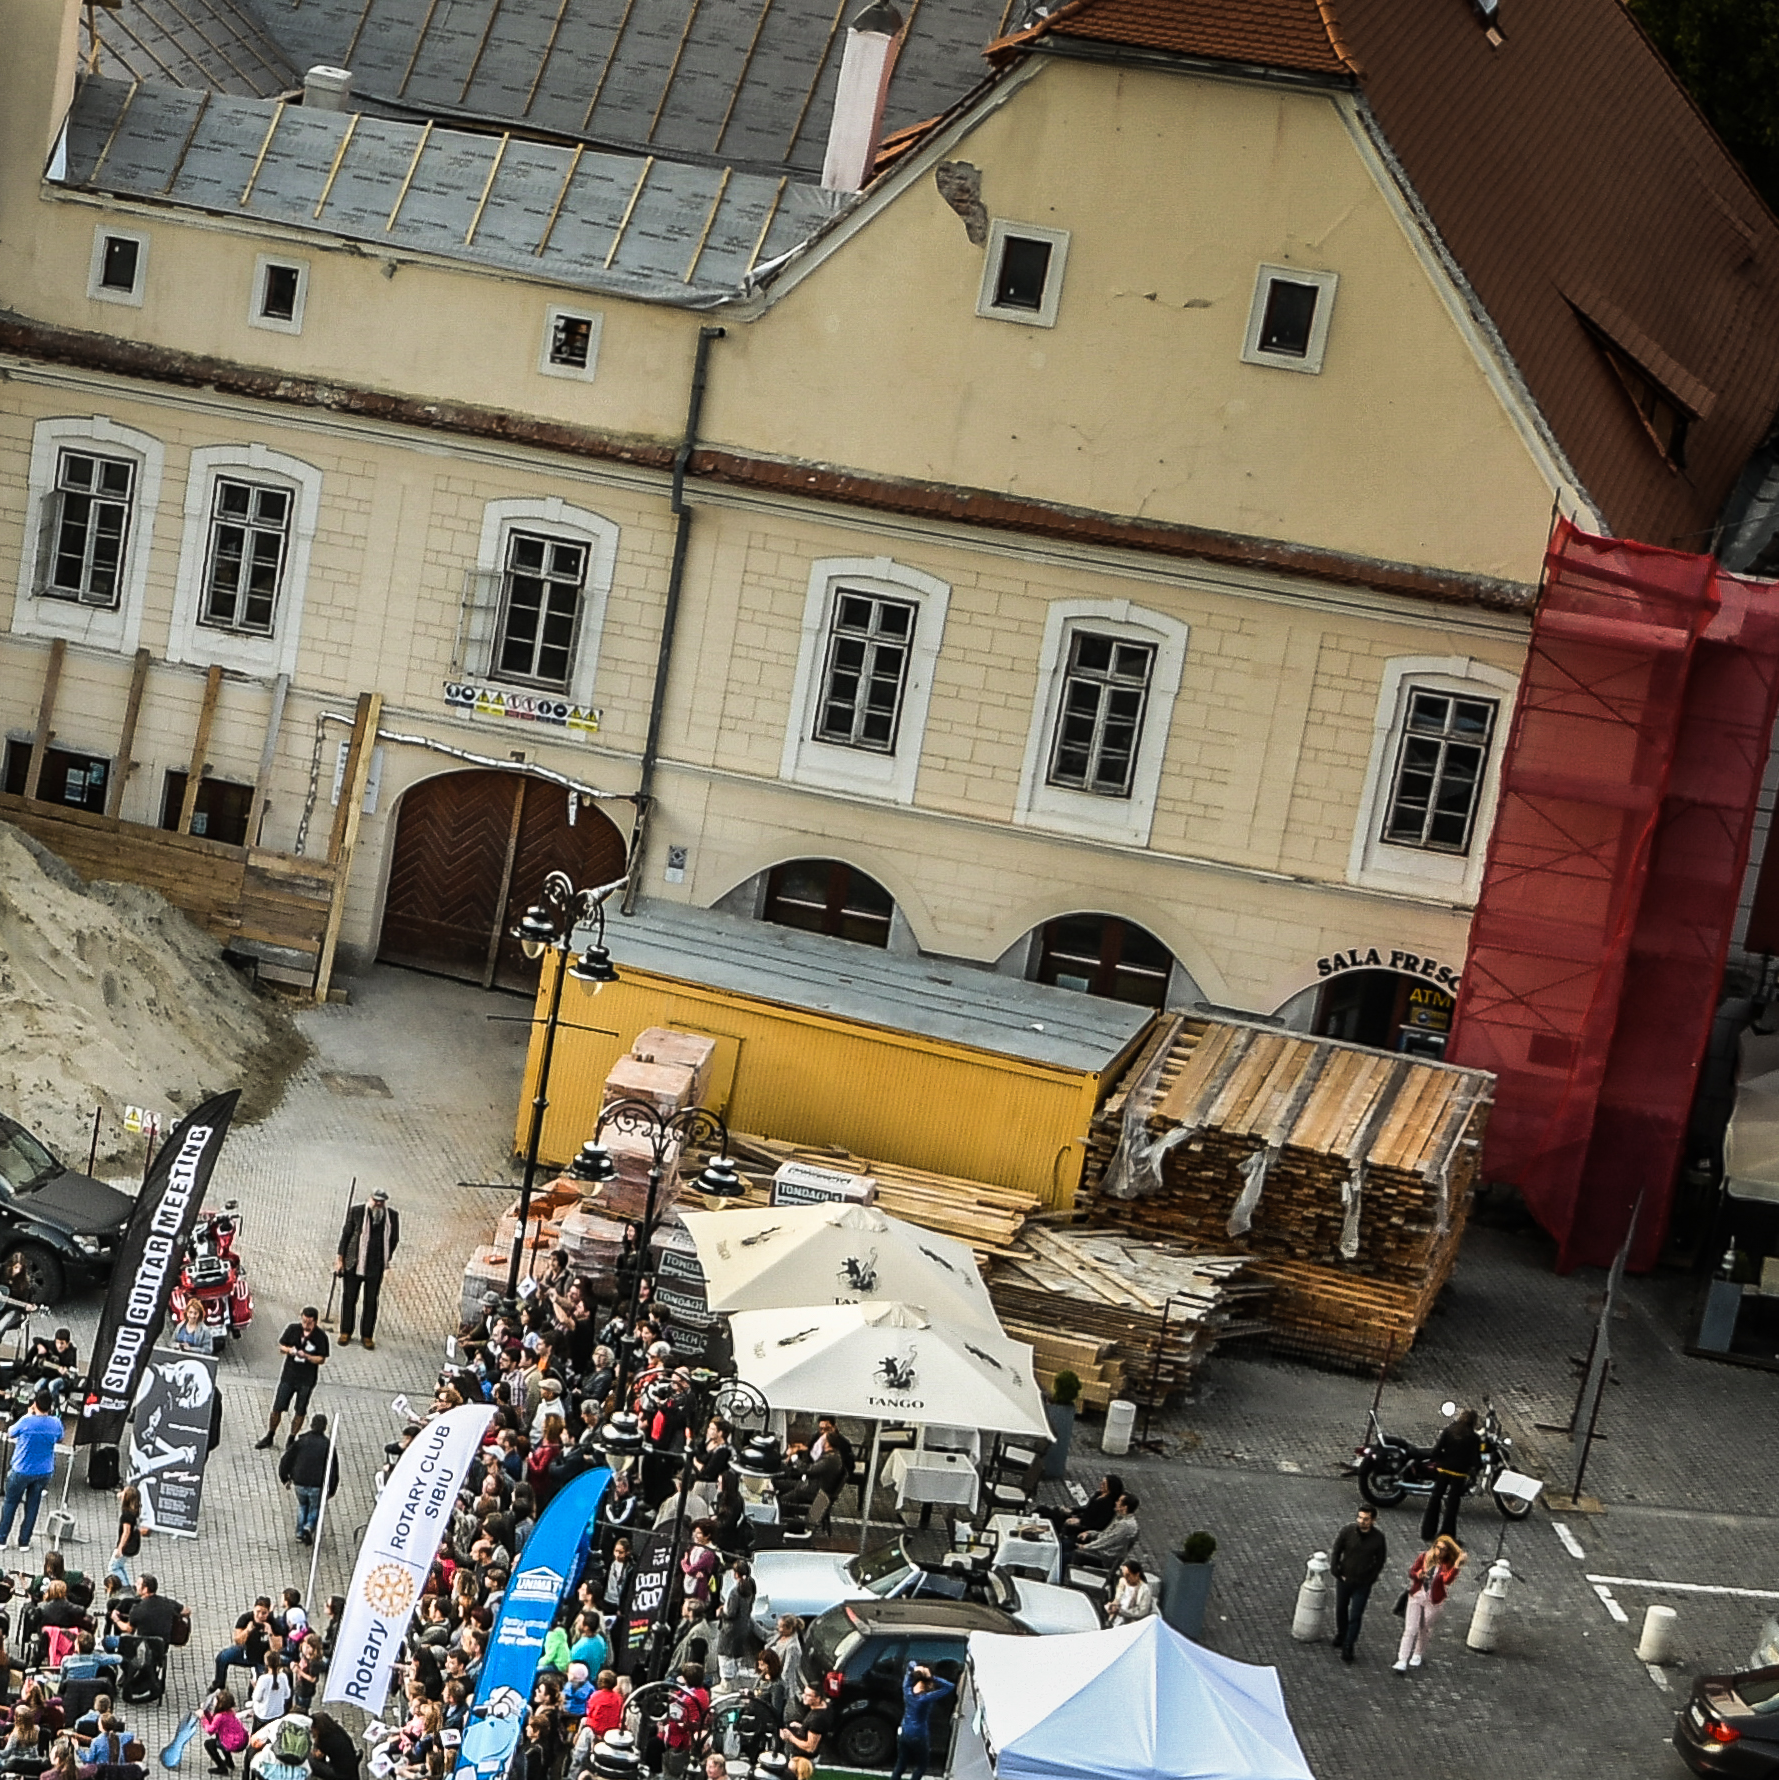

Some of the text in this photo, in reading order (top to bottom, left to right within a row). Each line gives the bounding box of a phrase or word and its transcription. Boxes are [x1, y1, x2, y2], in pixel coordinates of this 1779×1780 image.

[1316, 948, 1382, 977] SALA
[1410, 988, 1451, 1008] ATM
[105, 1328, 143, 1390] SIBIU
[130, 1237, 171, 1322] GUITAR
[157, 1127, 210, 1233] MEETING
[868, 1397, 925, 1409] TANGO
[390, 1424, 451, 1550] ROTARY CLUB
[425, 1468, 455, 1520] SIBIU
[515, 1577, 560, 1593] UNIMAT
[345, 1618, 389, 1701] Rotary
